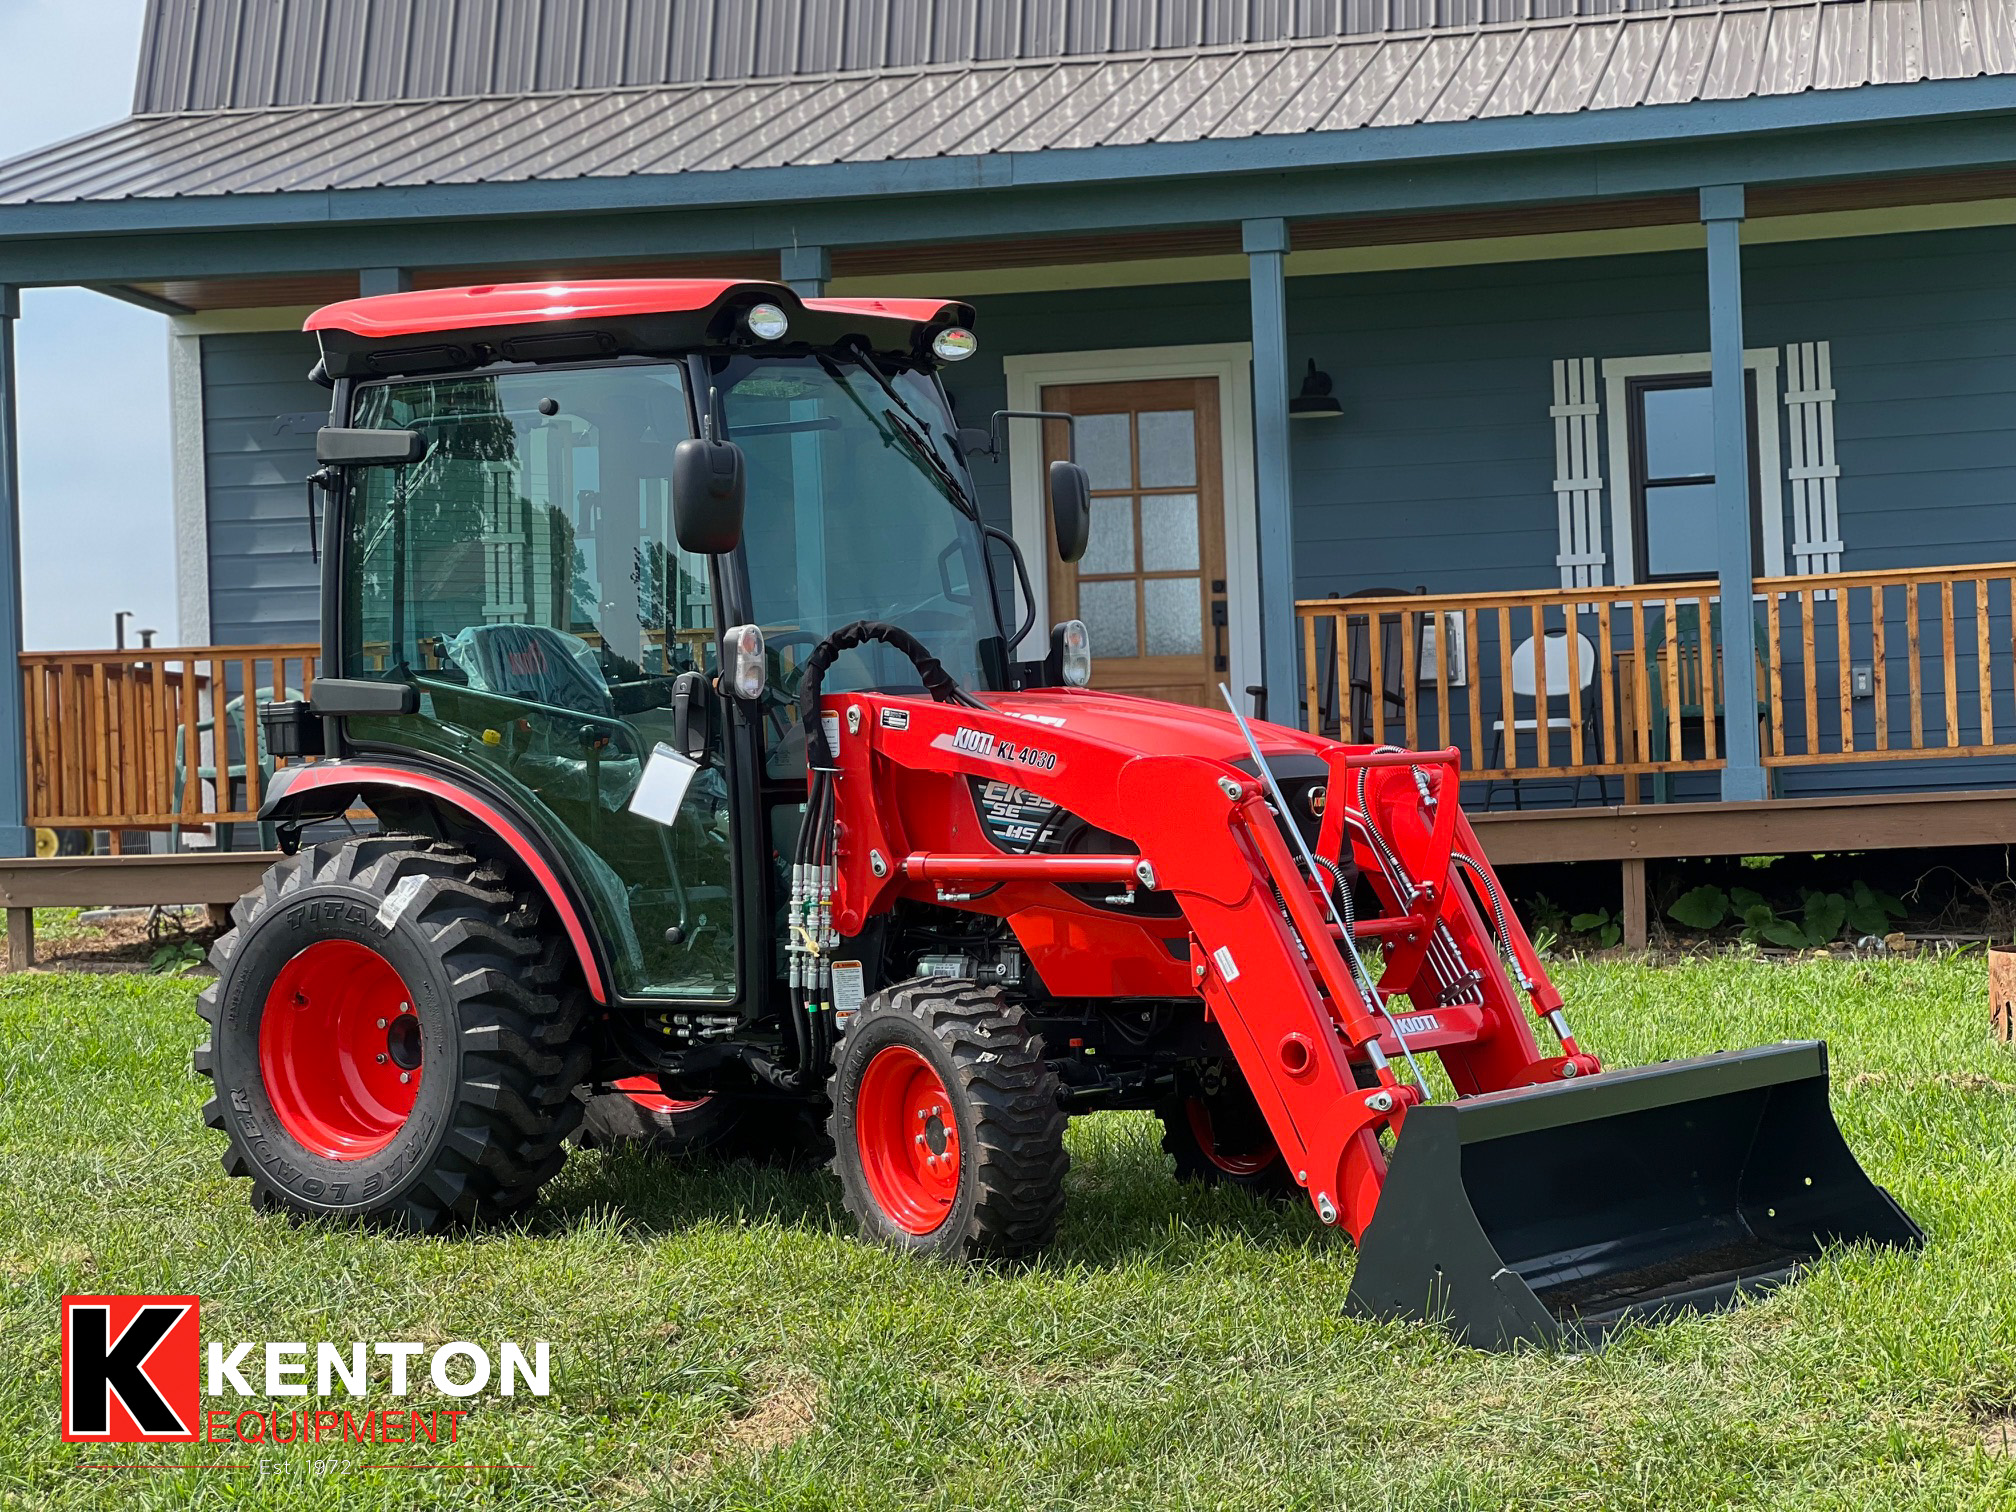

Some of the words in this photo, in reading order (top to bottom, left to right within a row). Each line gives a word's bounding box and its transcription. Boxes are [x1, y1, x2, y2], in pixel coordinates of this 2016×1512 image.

[952, 726, 995, 755] KIOTI
[997, 741, 1015, 761] KL
[1018, 746, 1057, 770] 4030
[991, 803, 1022, 818] SE
[1005, 824, 1053, 843] HST
[286, 900, 397, 938] TITAN
[1396, 1014, 1439, 1034] KIOTI
[230, 1087, 350, 1201] LOADER
